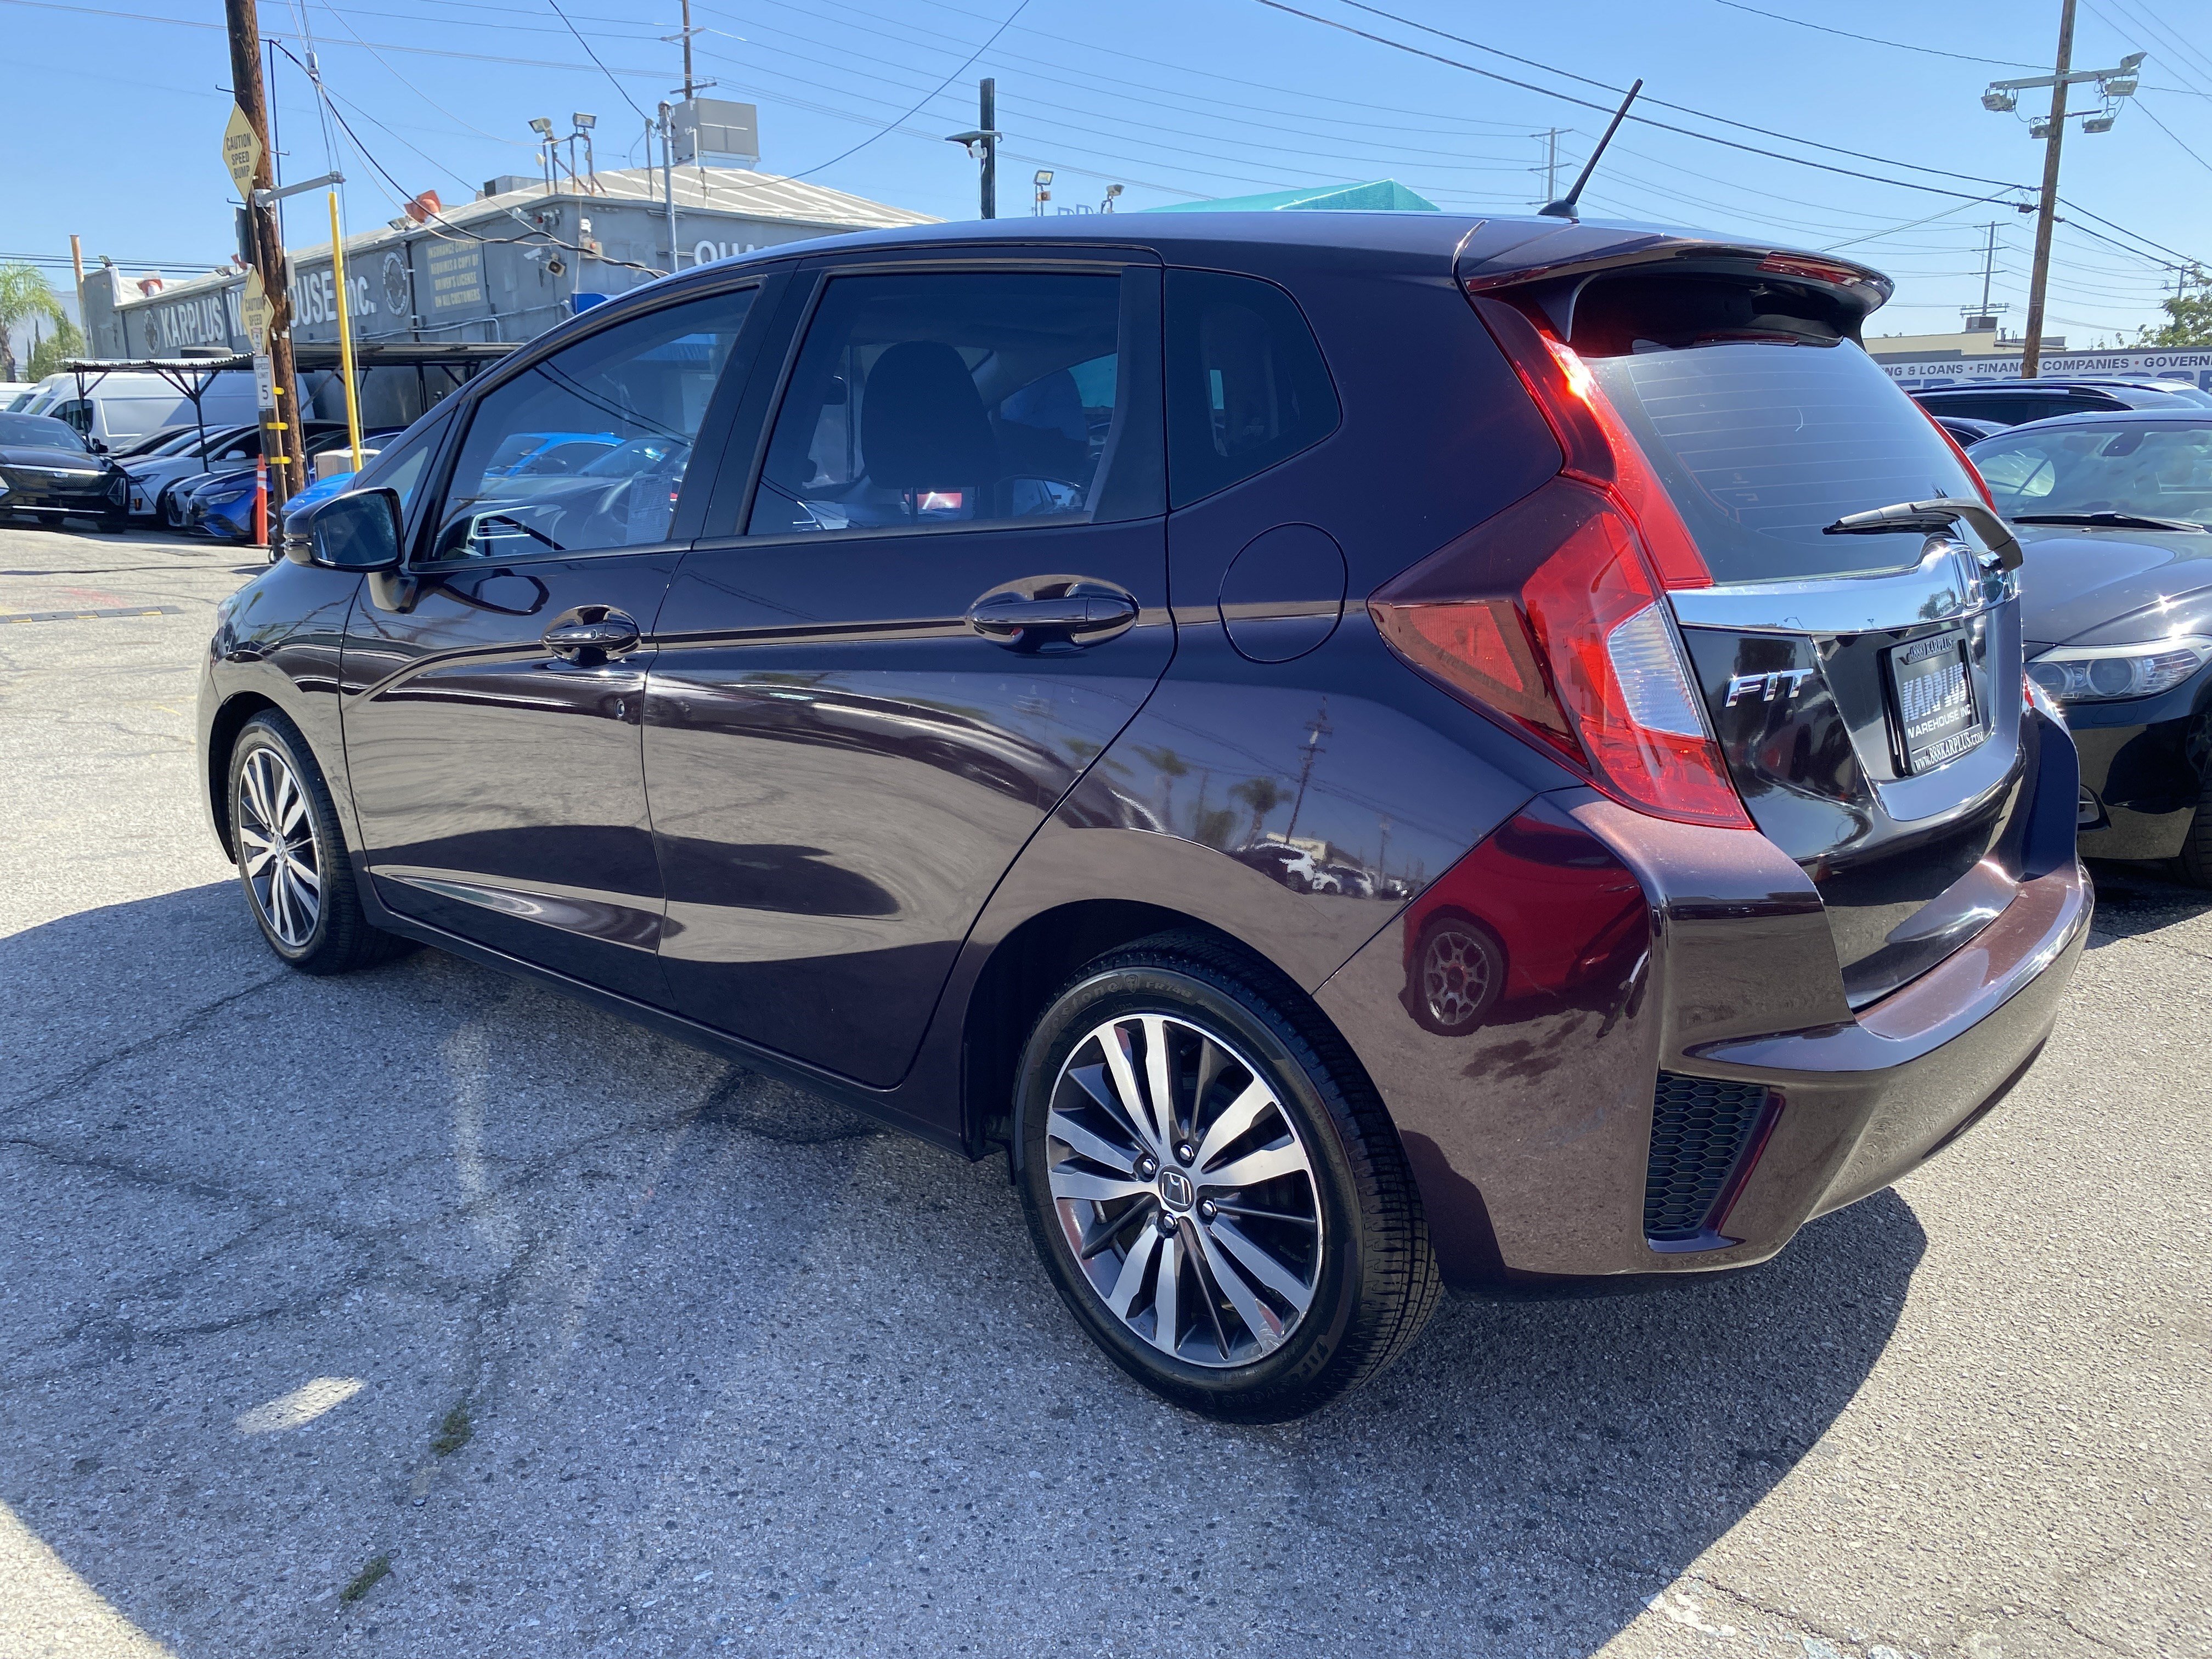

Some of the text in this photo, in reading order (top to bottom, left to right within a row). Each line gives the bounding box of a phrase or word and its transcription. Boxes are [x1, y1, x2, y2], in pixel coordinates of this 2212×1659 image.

[226, 132, 251, 151] CAUTION
[231, 151, 250, 166] SPEED
[233, 165, 250, 179] BUMP
[454, 258, 458, 270] A
[458, 255, 471, 269] COPY
[472, 253, 478, 266] OF
[245, 297, 264, 312] CAUTION
[451, 288, 481, 304] CUSTOMERS
[160, 297, 224, 348] KARPLUS
[249, 314, 262, 326] SPEED
[1908, 366, 1915, 376] &
[1920, 364, 1963, 375] LOANS
[2042, 358, 2129, 370] COMPANIES
[2144, 356, 2212, 368] GOVERN
[262, 385, 269, 400] 5
[1910, 636, 1953, 659] (888) KARPLUS
[1724, 668, 1814, 708] FIT
[1903, 662, 1966, 723] KARPLUS
[1907, 704, 1971, 740] WAREHOUSE INC
